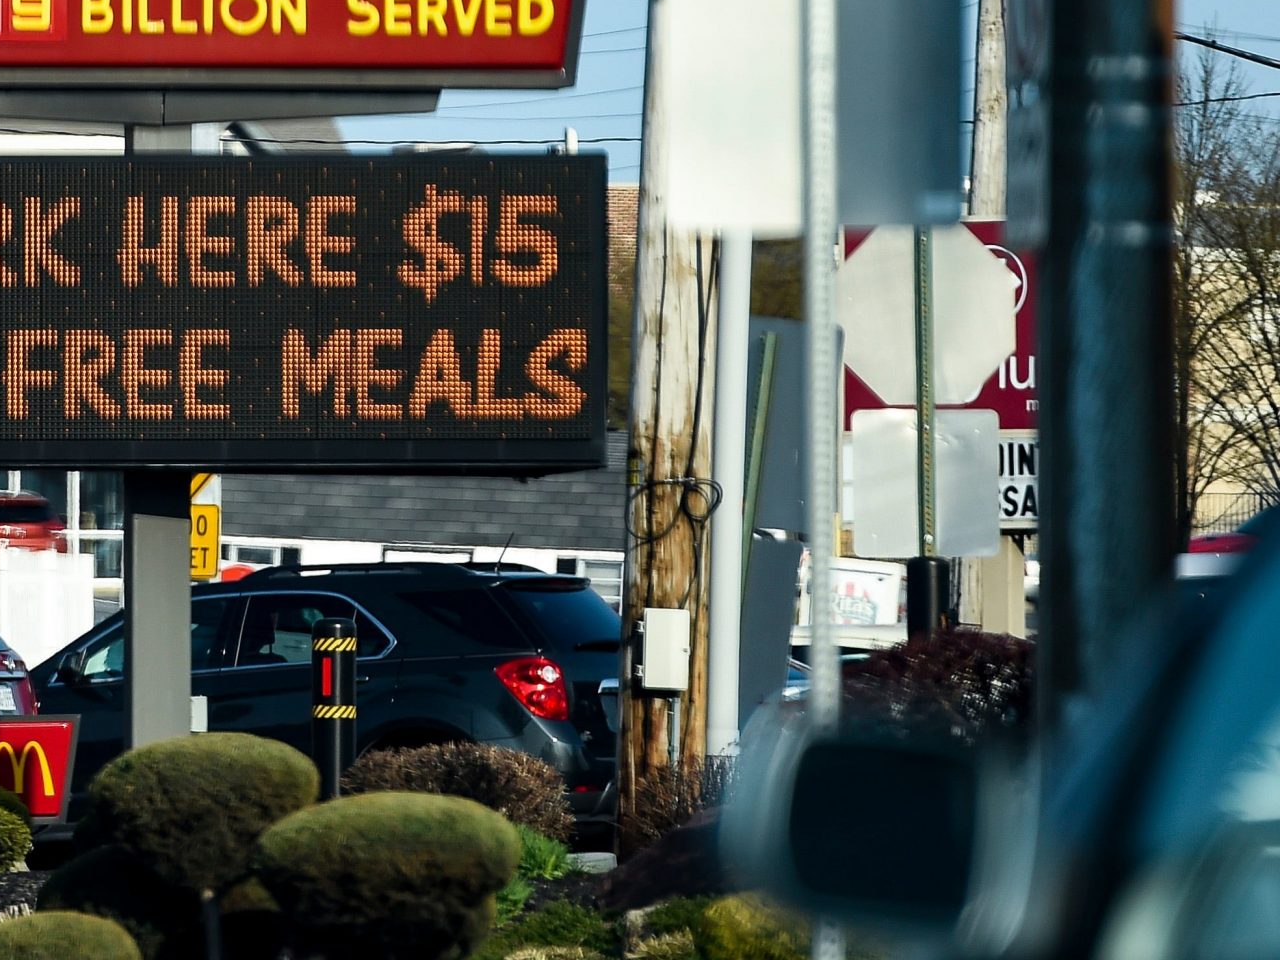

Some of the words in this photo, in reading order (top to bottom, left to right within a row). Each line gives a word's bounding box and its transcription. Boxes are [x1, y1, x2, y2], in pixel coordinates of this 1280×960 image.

[118, 195, 358, 288] HERE
[397, 184, 559, 301] $15
[2, 328, 231, 420] FREE
[280, 328, 588, 420] MEALS
